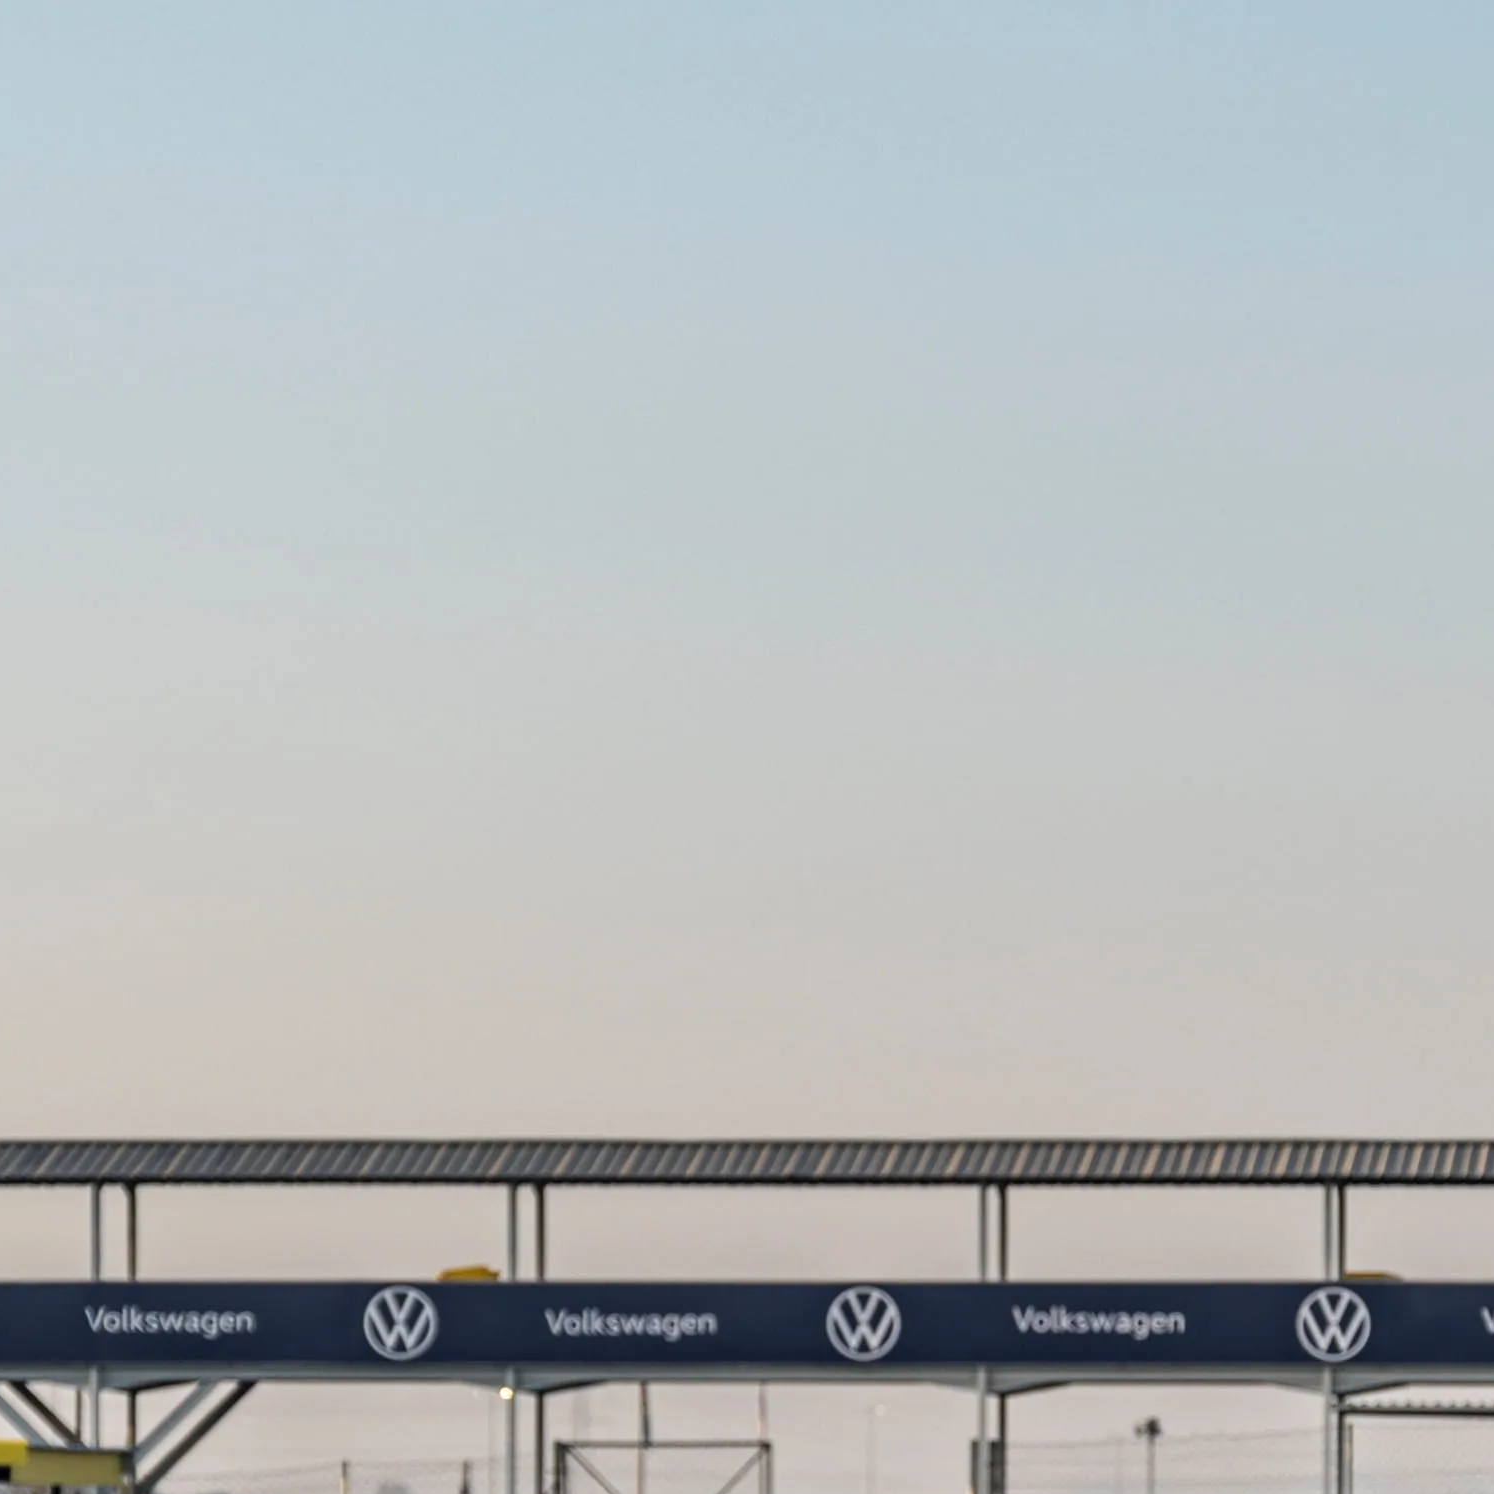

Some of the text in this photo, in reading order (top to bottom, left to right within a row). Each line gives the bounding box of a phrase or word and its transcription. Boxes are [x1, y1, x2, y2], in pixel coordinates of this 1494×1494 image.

[85, 1304, 256, 1339] Volkswagen
[544, 1304, 720, 1340] Volkswagen
[1012, 1306, 1186, 1340] Volkswagen
